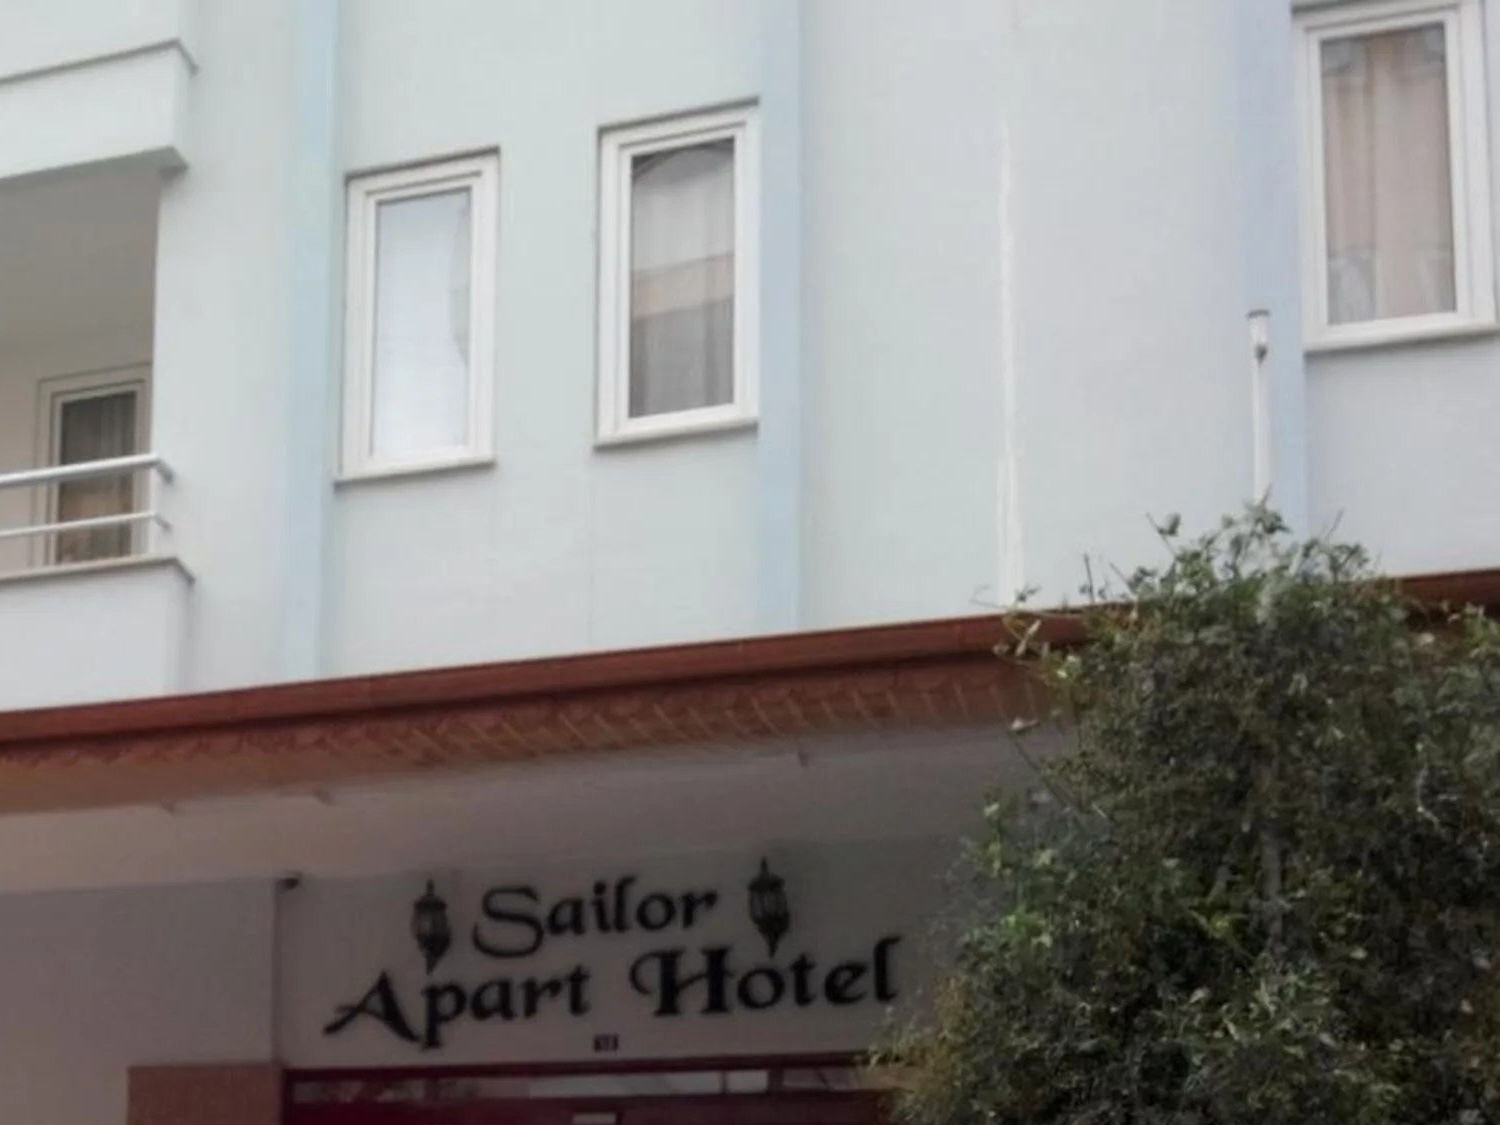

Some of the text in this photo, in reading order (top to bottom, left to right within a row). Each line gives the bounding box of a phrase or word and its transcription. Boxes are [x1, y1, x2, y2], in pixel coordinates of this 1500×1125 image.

[472, 874, 720, 959] Sailor
[321, 935, 903, 1050] Apart Hotel
